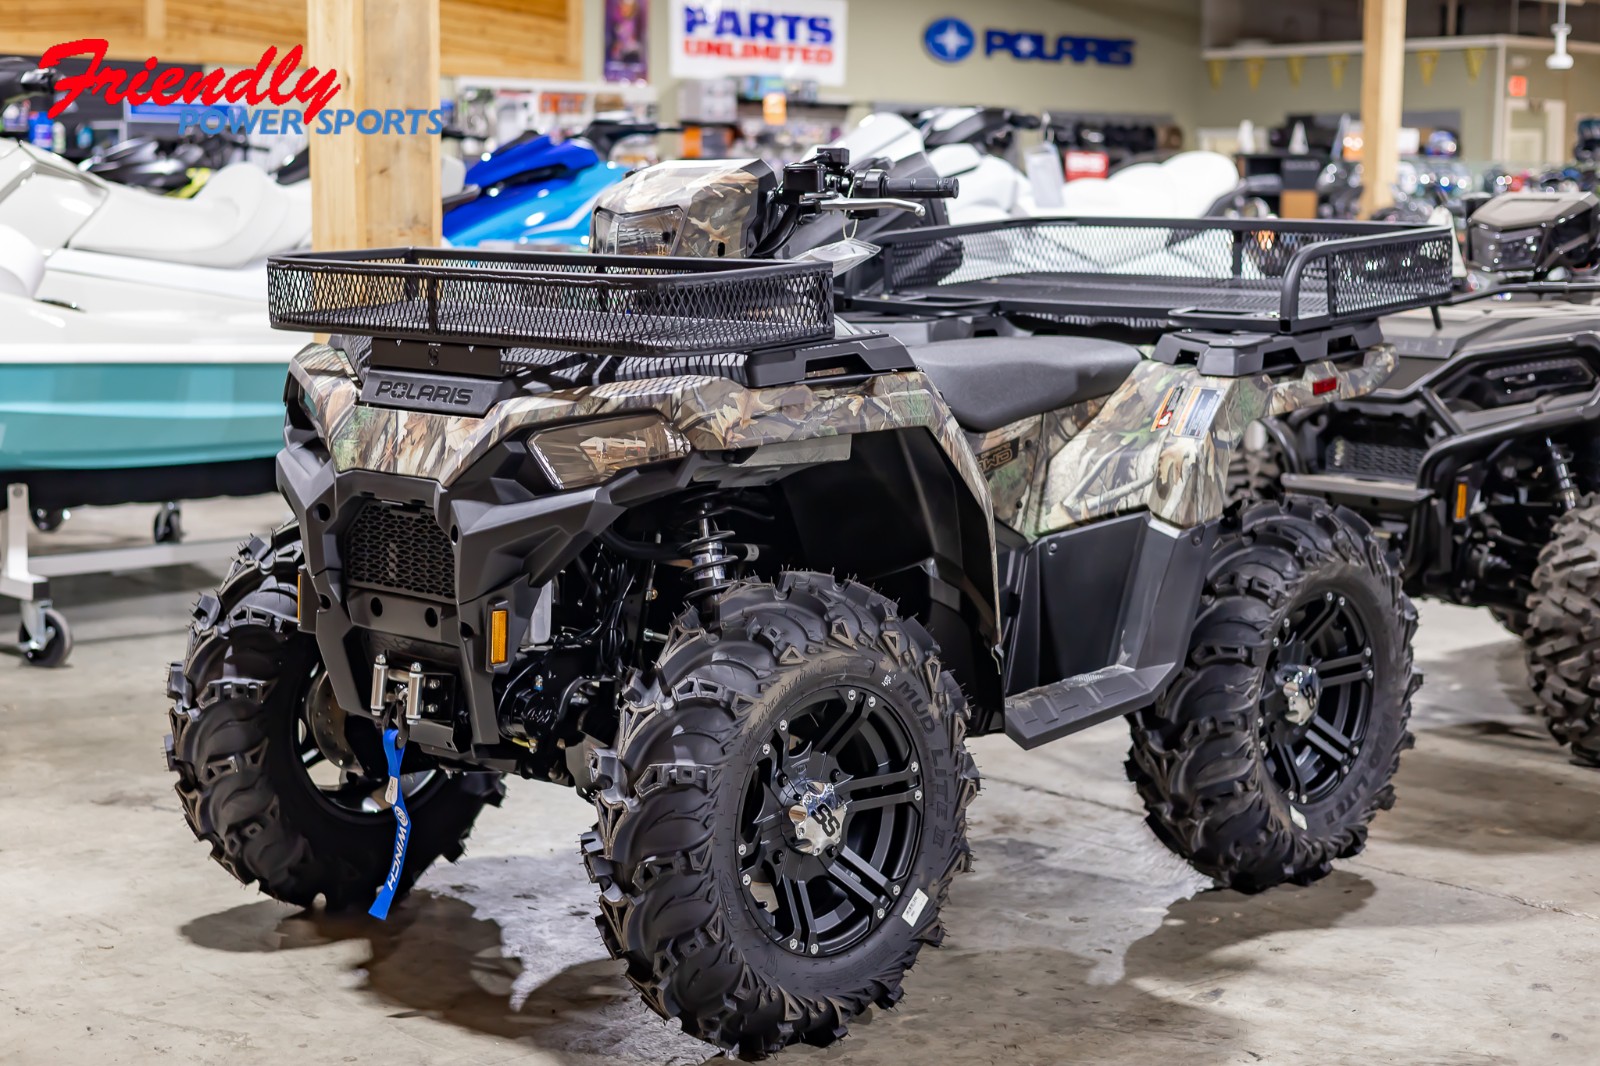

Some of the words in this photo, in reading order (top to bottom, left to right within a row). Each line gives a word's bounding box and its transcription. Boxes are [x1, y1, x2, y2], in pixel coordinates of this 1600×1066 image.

[684, 7, 833, 44] PARTS
[684, 39, 833, 64] UNLIMITED
[985, 29, 1135, 66] POLARIS
[375, 381, 473, 405] POLARIS
[897, 680, 936, 736] MUD
[930, 748, 948, 821] LITE
[387, 826, 407, 892] WINCH
